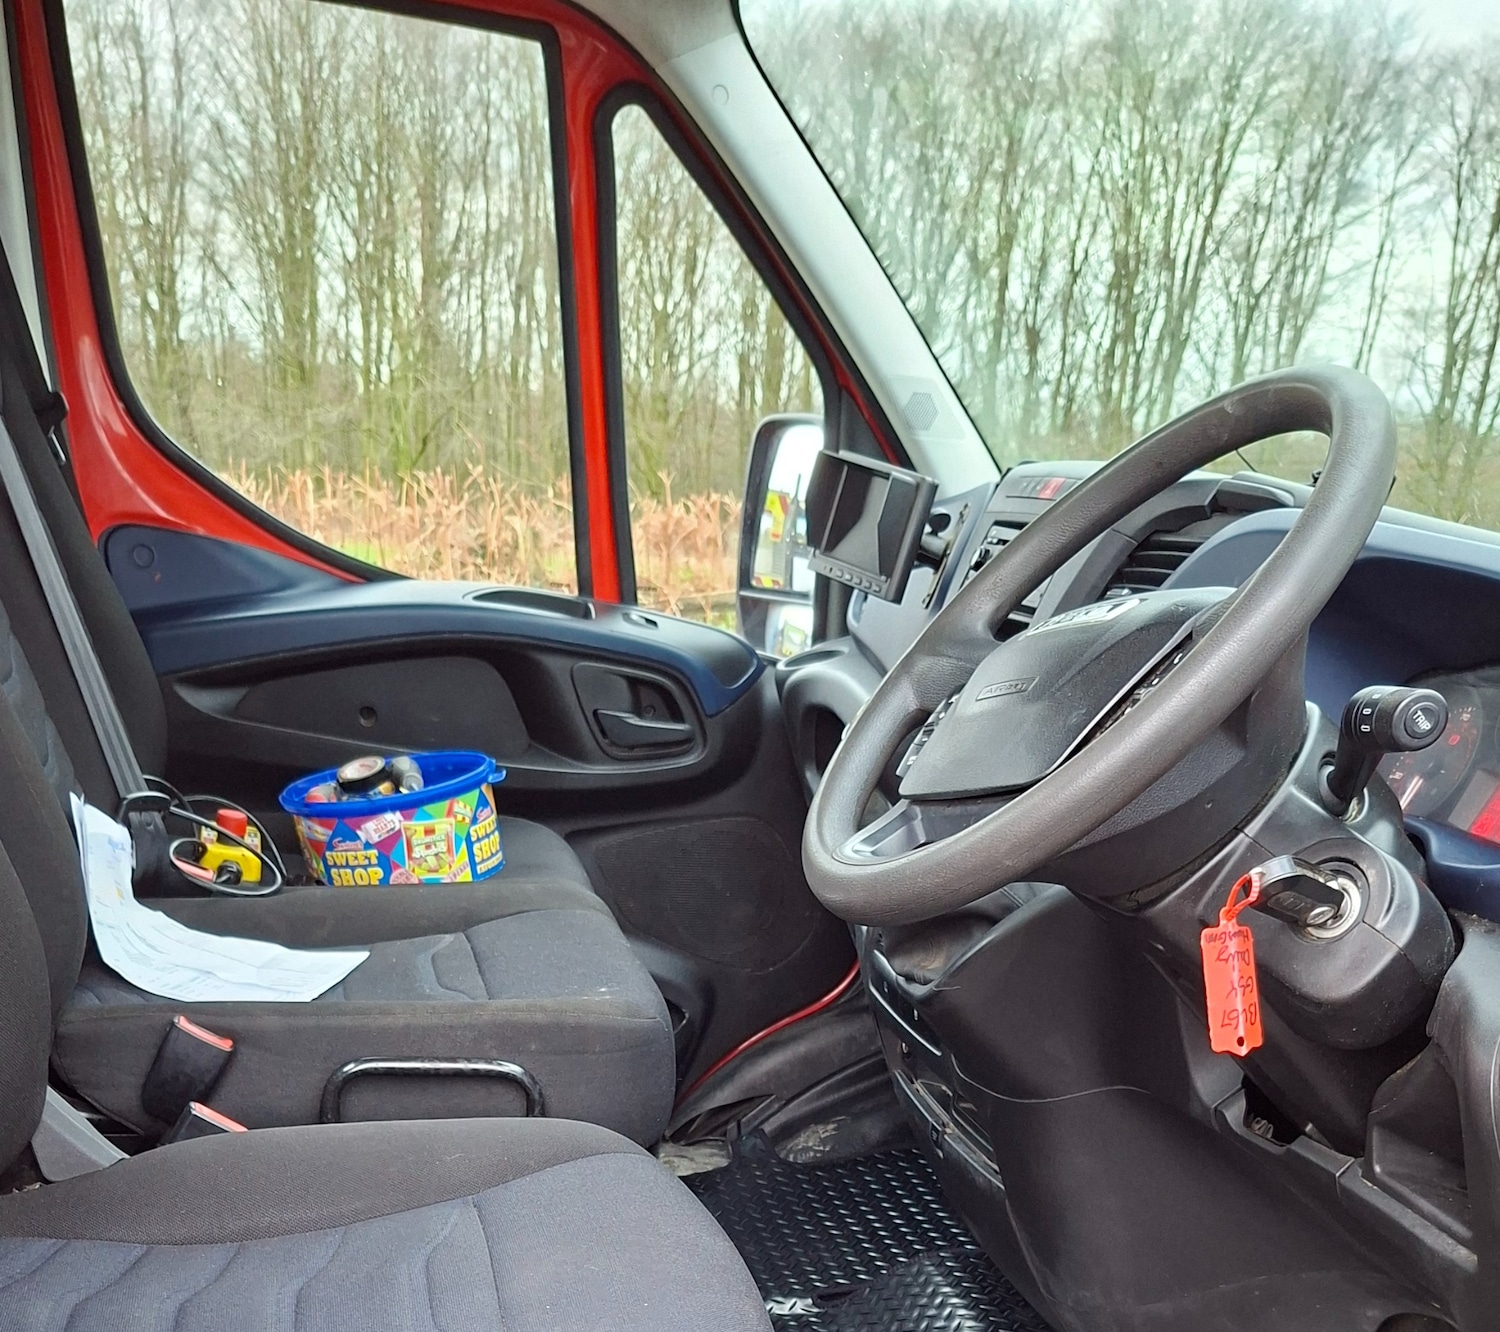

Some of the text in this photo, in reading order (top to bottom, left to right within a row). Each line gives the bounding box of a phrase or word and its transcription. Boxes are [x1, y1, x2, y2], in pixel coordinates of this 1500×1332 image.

[1412, 709, 1432, 731] TRIP
[325, 851, 379, 867] SWEET
[330, 867, 384, 887] SHOP
